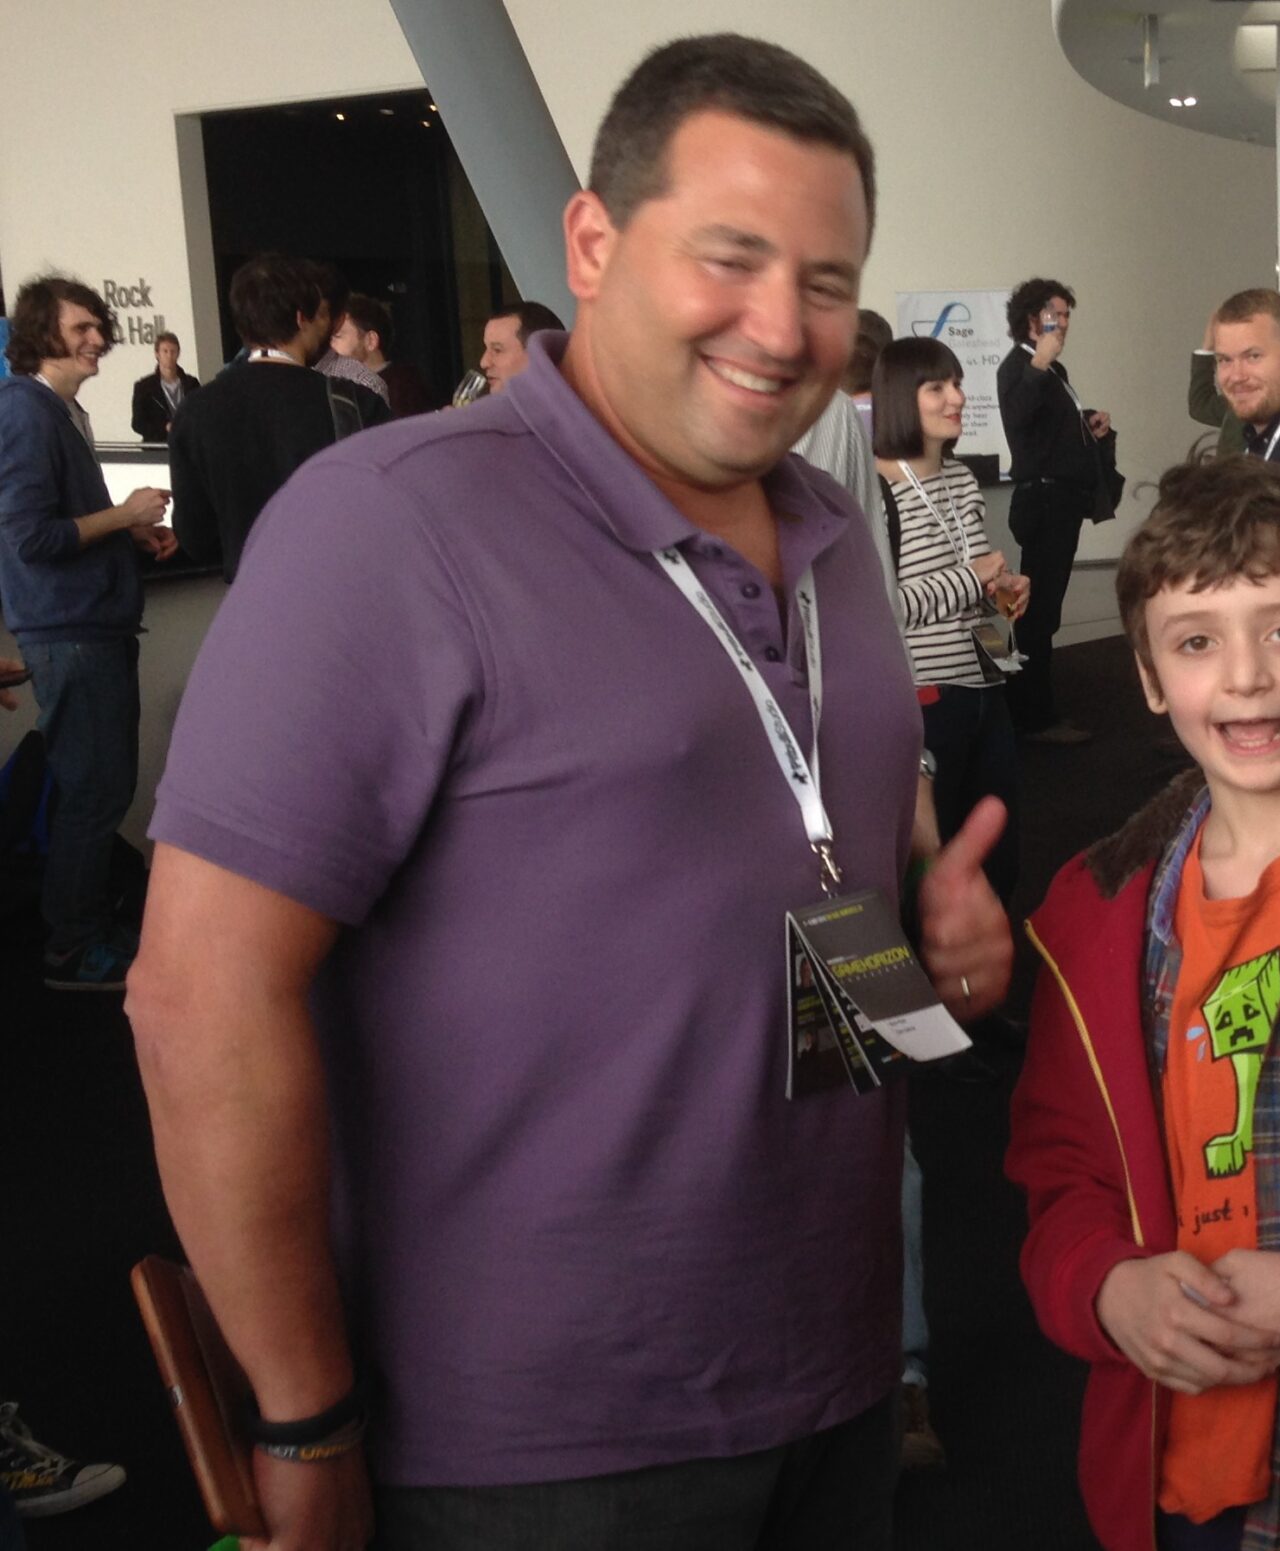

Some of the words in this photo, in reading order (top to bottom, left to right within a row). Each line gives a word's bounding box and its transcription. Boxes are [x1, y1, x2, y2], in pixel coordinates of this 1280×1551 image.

[103, 278, 153, 308] Rock
[128, 315, 165, 345] Hall
[948, 326, 974, 338] Sage
[1193, 1197, 1232, 1237] just
